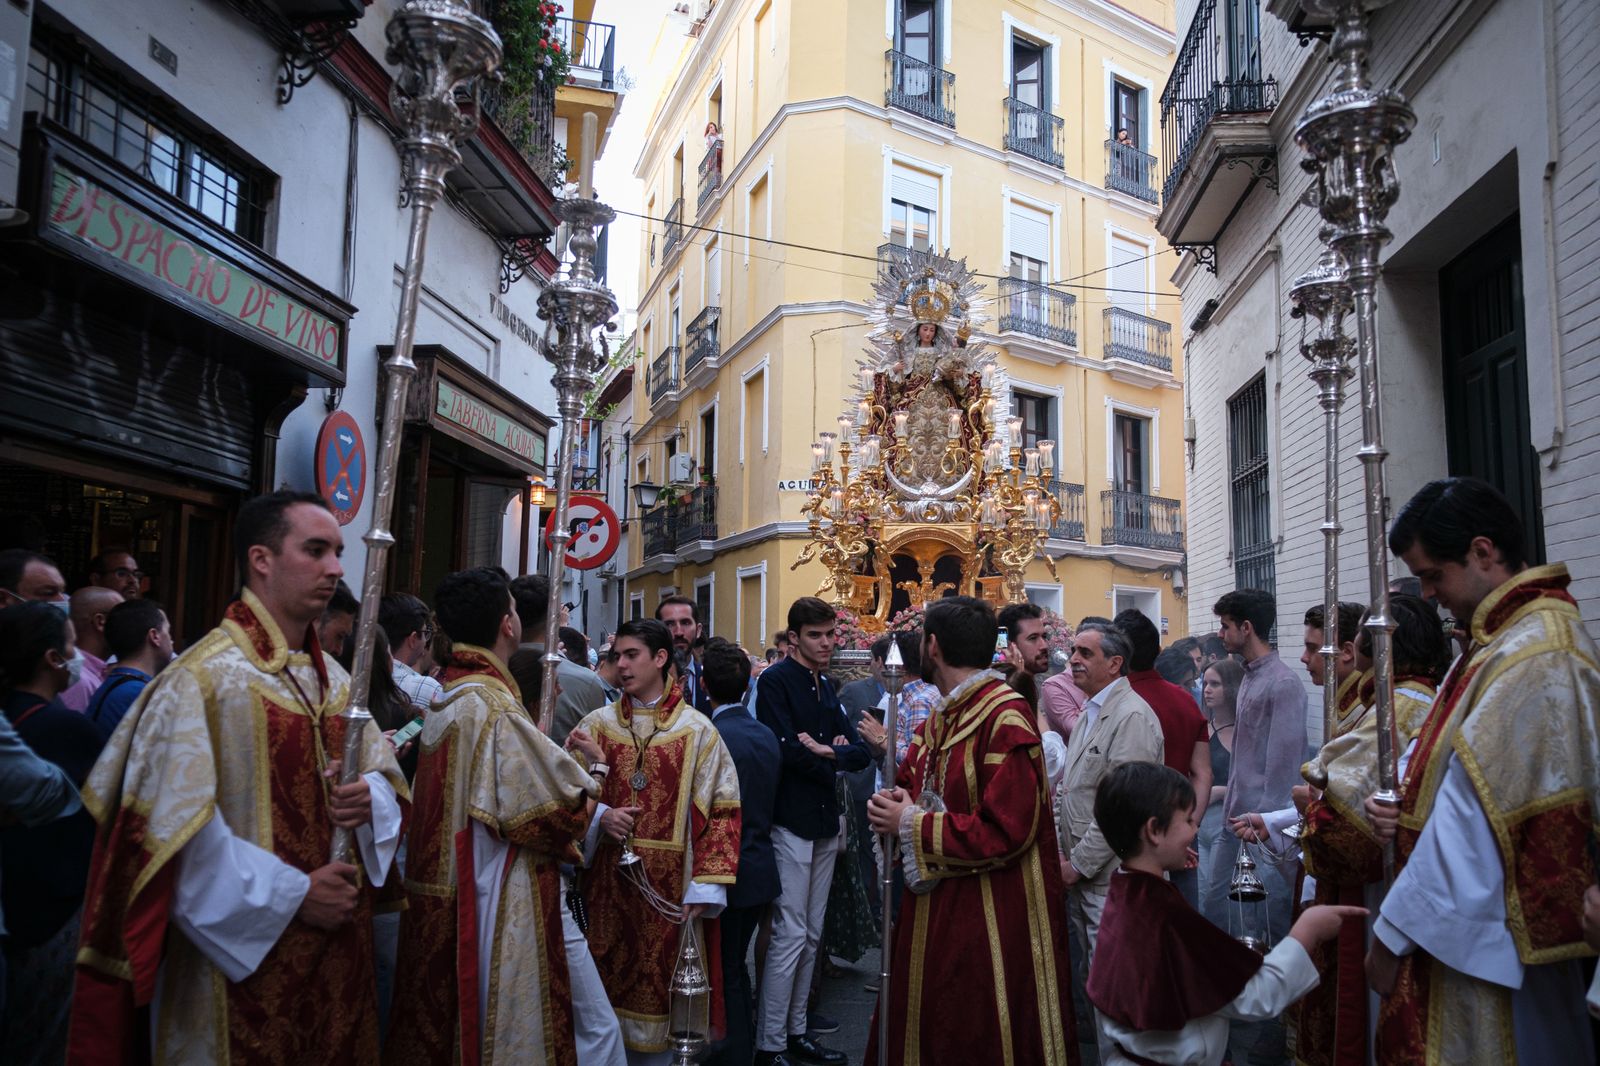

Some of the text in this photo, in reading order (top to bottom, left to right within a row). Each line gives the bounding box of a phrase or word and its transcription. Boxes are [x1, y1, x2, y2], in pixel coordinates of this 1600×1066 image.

[52, 182, 338, 361] DESPACHO DE VINO
[449, 390, 497, 442] TABERNA
